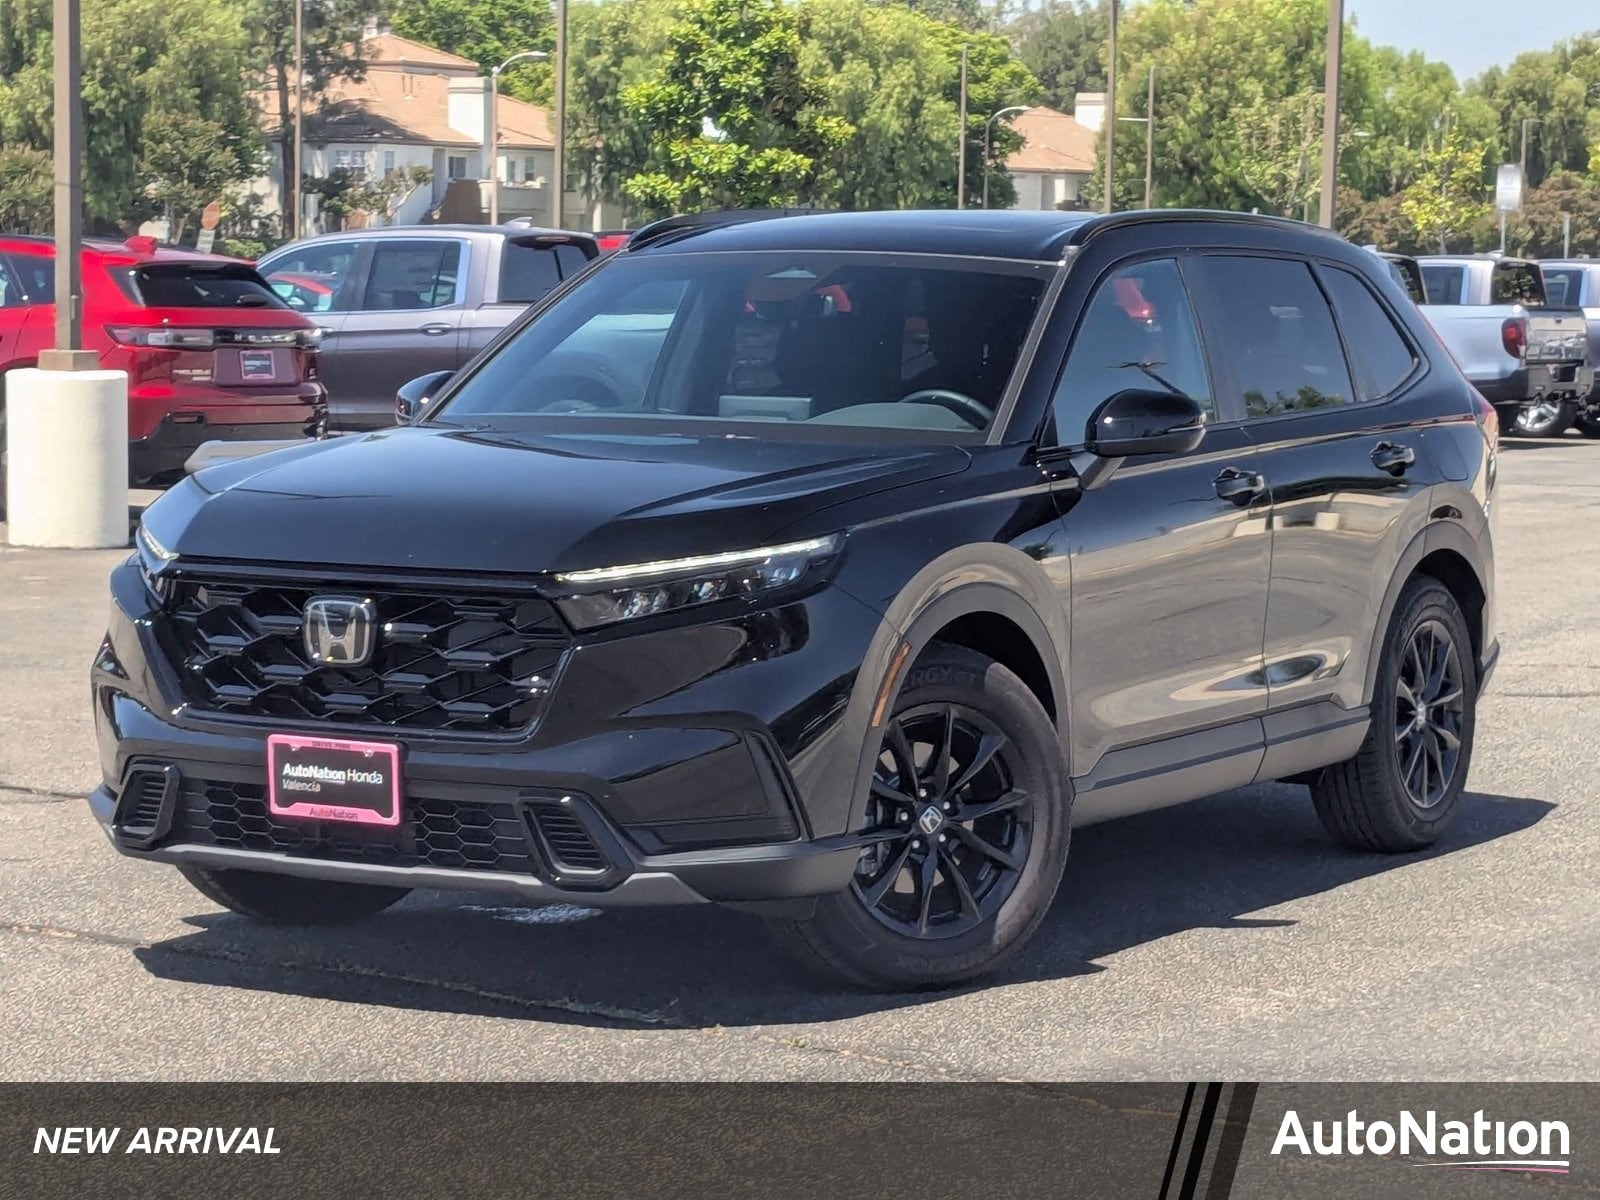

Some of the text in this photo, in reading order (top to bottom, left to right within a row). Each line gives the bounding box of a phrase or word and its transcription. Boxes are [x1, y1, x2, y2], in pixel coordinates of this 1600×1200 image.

[282, 762, 383, 784] AutoNation Honda
[282, 778, 321, 792] Valencia
[309, 807, 359, 821] AutoNation
